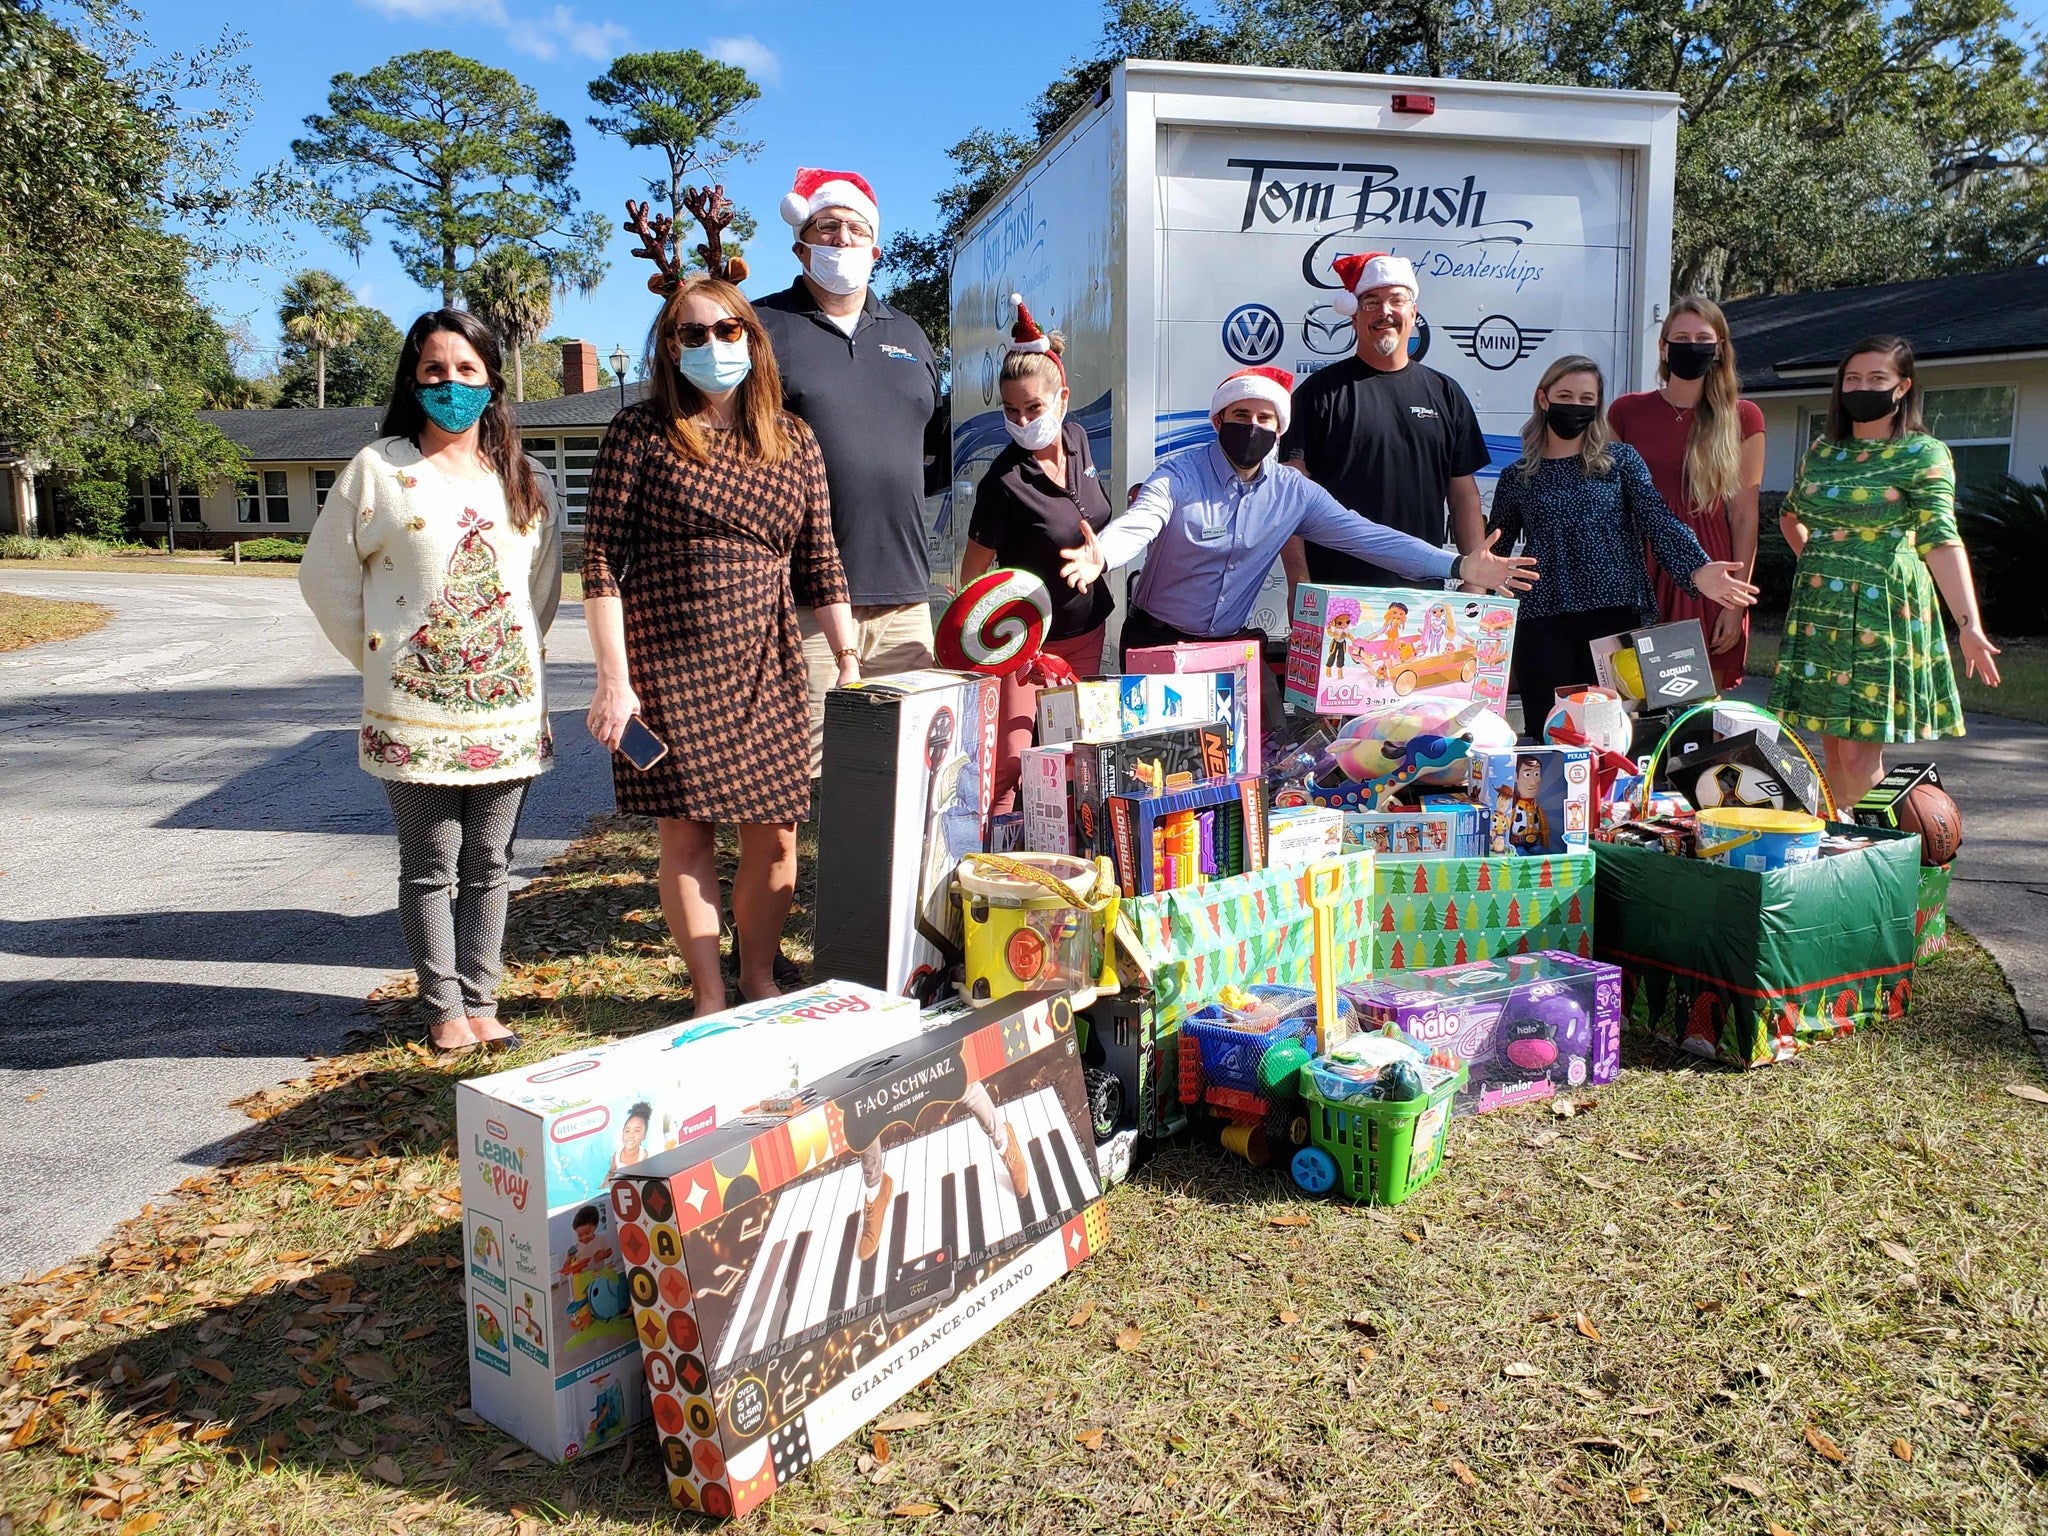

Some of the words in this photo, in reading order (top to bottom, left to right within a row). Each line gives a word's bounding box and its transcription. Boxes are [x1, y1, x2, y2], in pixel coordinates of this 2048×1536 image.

[1227, 158, 1339, 233] Tom
[1342, 162, 1533, 233] Bush
[1430, 252, 1545, 294] Dealerships
[1480, 335, 1516, 351] MINI
[1659, 664, 1692, 679] umbro
[1567, 752, 1588, 760] PIXAR
[1108, 764, 1116, 797] ATTENT
[1115, 806, 1132, 888] TETRASHOT
[1935, 834, 1943, 850] PRO
[892, 1058, 952, 1100] SCHWARZ
[1501, 1080, 1534, 1098] junior
[893, 1098, 911, 1113] SINCE
[682, 1115, 714, 1137] Tunnel
[482, 1163, 493, 1187] &
[616, 1188, 634, 1214] F
[656, 1232, 675, 1256] A
[851, 1355, 904, 1402] GIANT
[909, 1296, 986, 1361] DANCE-ON
[990, 1263, 1033, 1301] PIANO
[576, 1364, 595, 1379] Easy
[596, 1349, 627, 1368] Storage
[652, 1360, 671, 1383] A
[690, 1402, 710, 1430] O
[737, 1383, 755, 1399] OVER
[737, 1400, 744, 1411] 5
[745, 1389, 758, 1407] FT
[738, 1400, 762, 1424] (1.5m)
[743, 1414, 761, 1430] LONG!
